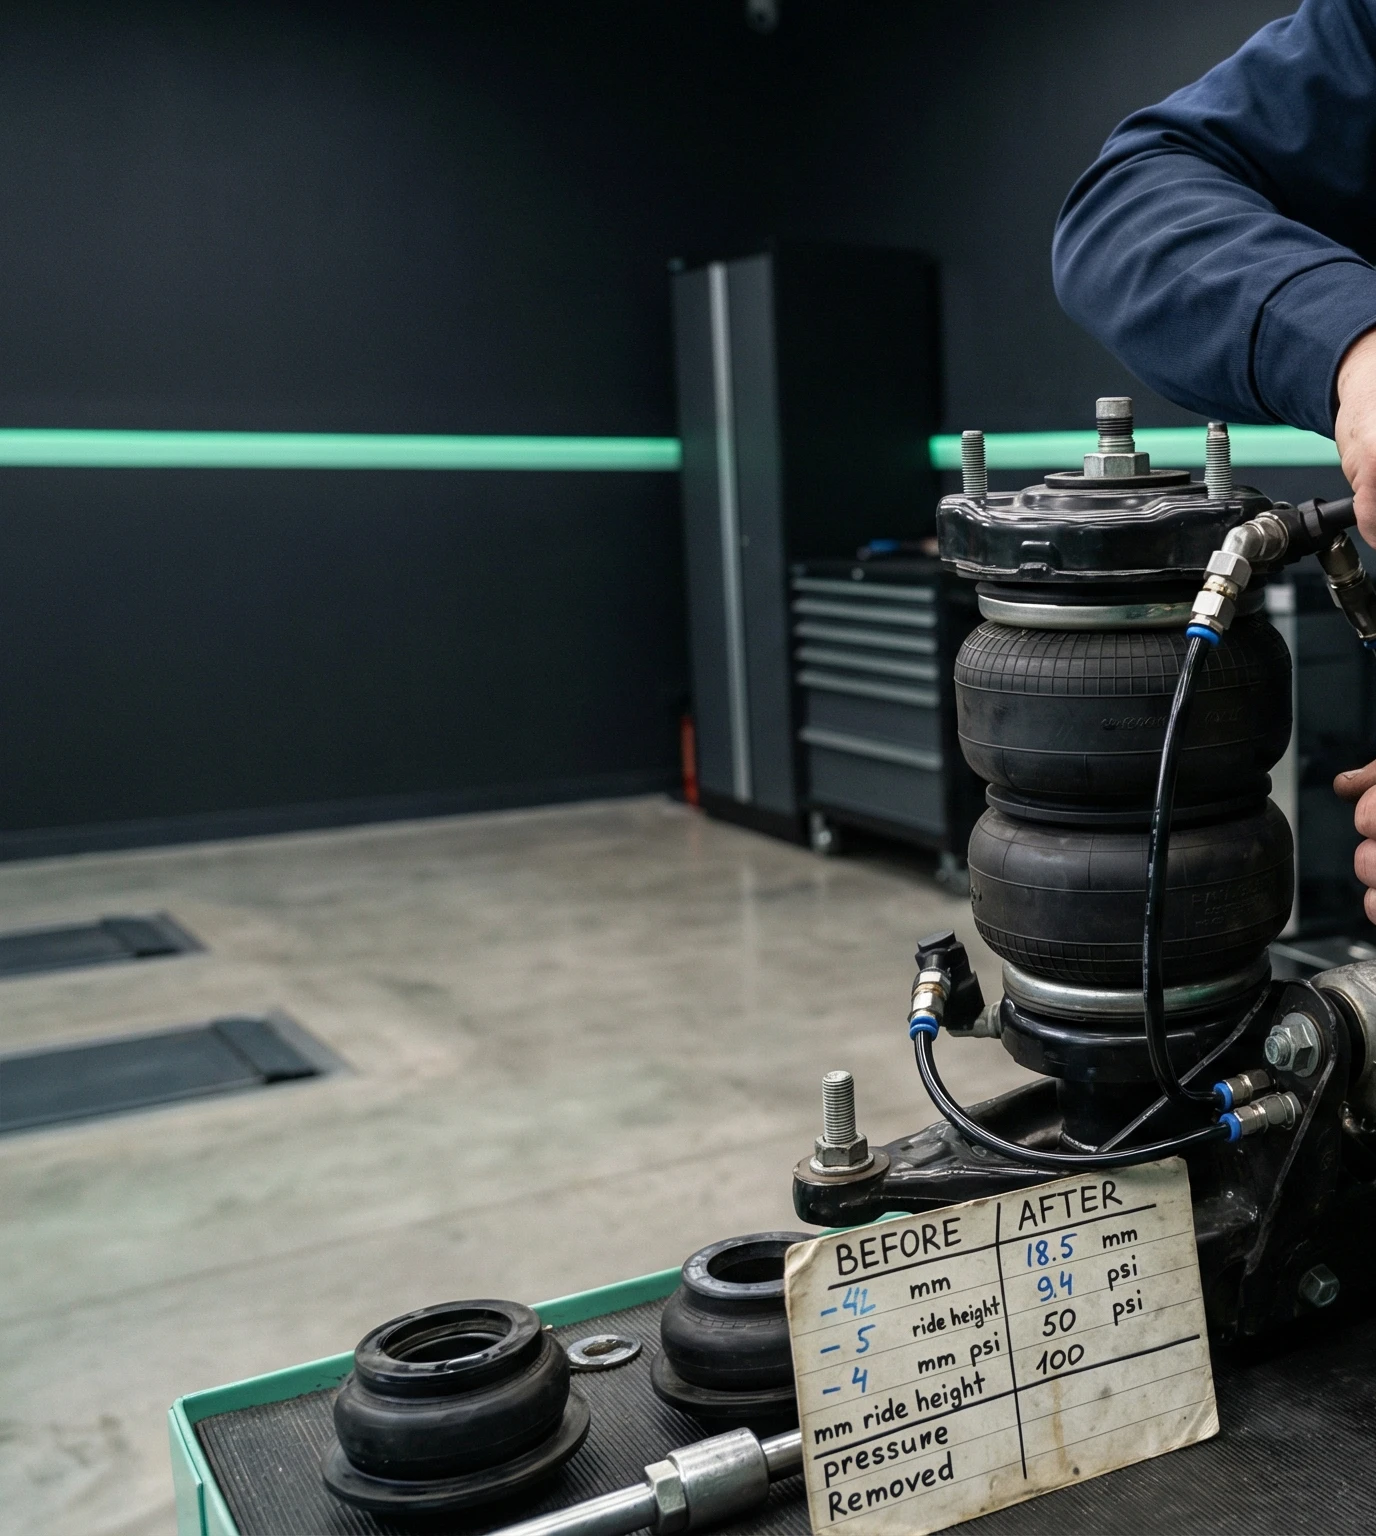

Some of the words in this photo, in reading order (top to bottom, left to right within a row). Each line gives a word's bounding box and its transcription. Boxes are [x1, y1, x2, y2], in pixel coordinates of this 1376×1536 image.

[1018, 1180, 1123, 1231] AFTER
[836, 1217, 962, 1276] BEFORE
[1026, 1233, 1078, 1268] 18.5
[1102, 1228, 1138, 1250] mm
[910, 1275, 952, 1299] mm
[1037, 1271, 1074, 1302] 9.4
[1107, 1256, 1138, 1291] psi
[912, 1314, 946, 1338] ride
[950, 1296, 1001, 1332] height
[1042, 1309, 1076, 1337] 50
[1112, 1291, 1143, 1326] psi
[918, 1352, 956, 1374] mm
[970, 1333, 1000, 1367] psi
[1035, 1344, 1084, 1375] 100
[814, 1421, 853, 1444] mm
[863, 1397, 907, 1428] ride
[916, 1373, 986, 1413] height
[823, 1425, 948, 1487] pressure
[828, 1452, 954, 1521] Removed
